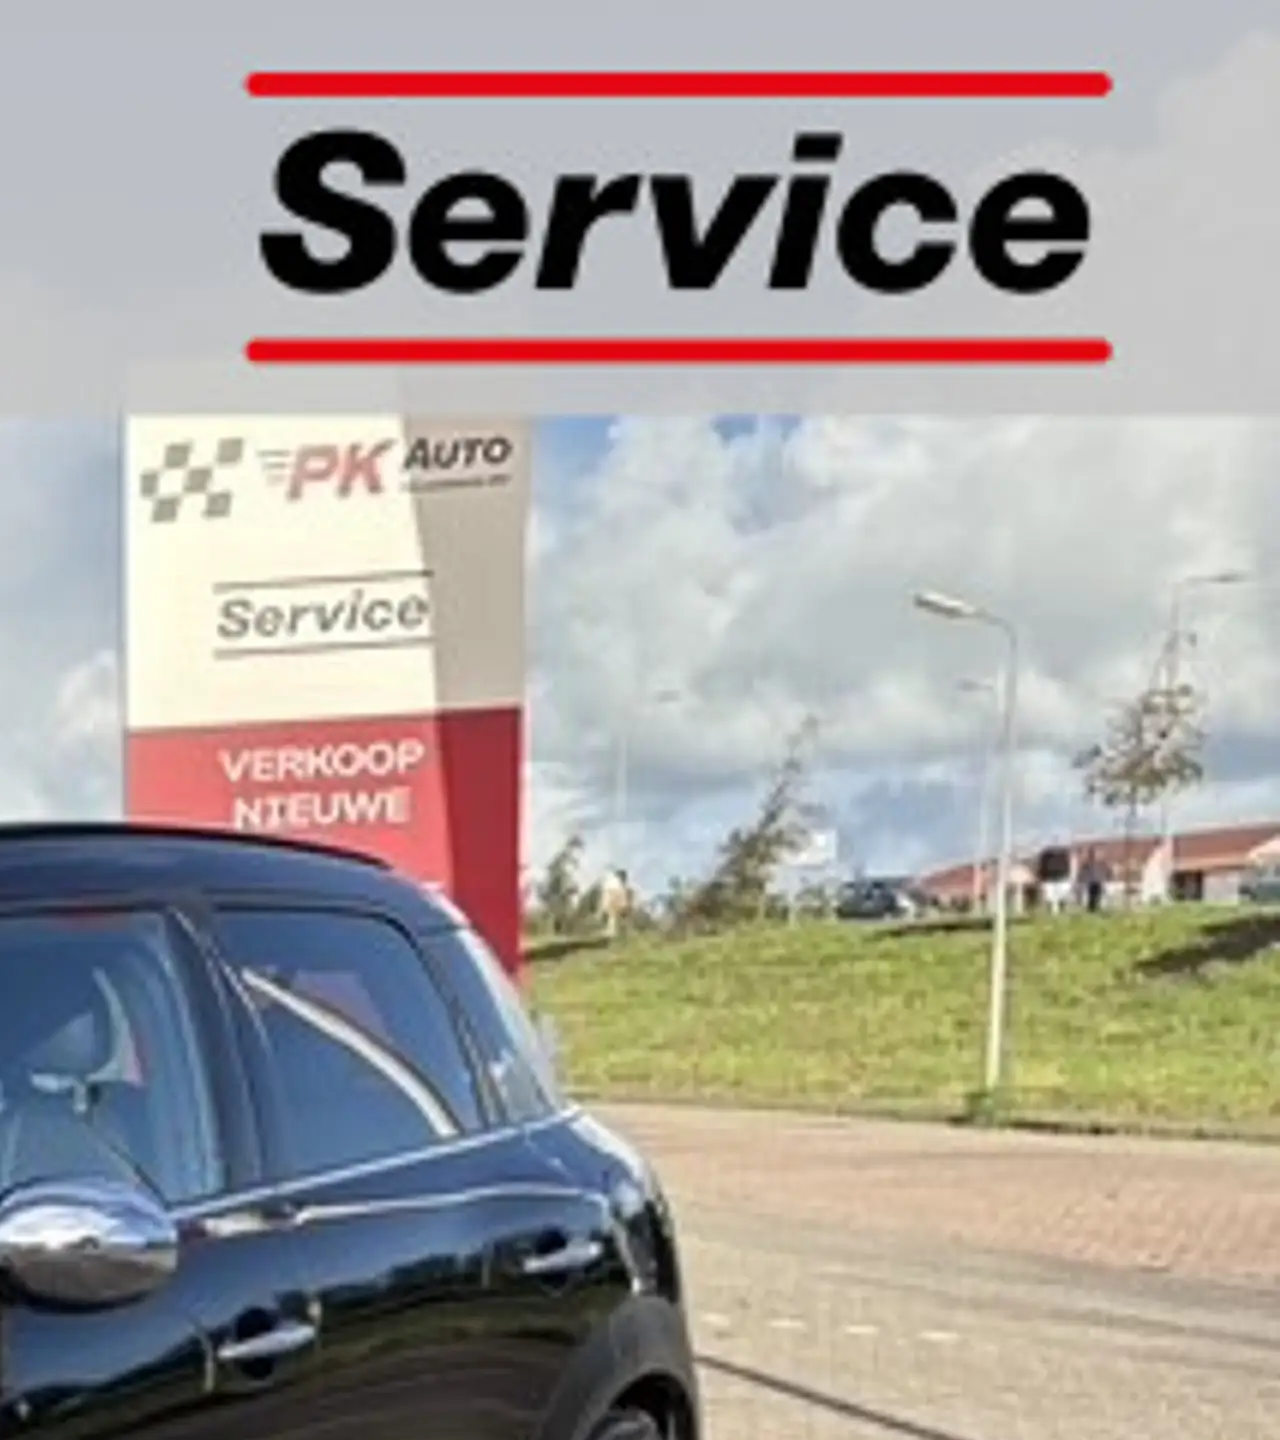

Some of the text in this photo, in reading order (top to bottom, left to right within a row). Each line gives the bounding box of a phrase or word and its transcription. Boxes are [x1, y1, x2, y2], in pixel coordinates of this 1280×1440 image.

[286, 438, 397, 501] PK
[402, 435, 515, 471] AUTO
[216, 589, 430, 641] Service
[217, 738, 426, 784] VERKOOP
[233, 787, 413, 831] NIEUWE
